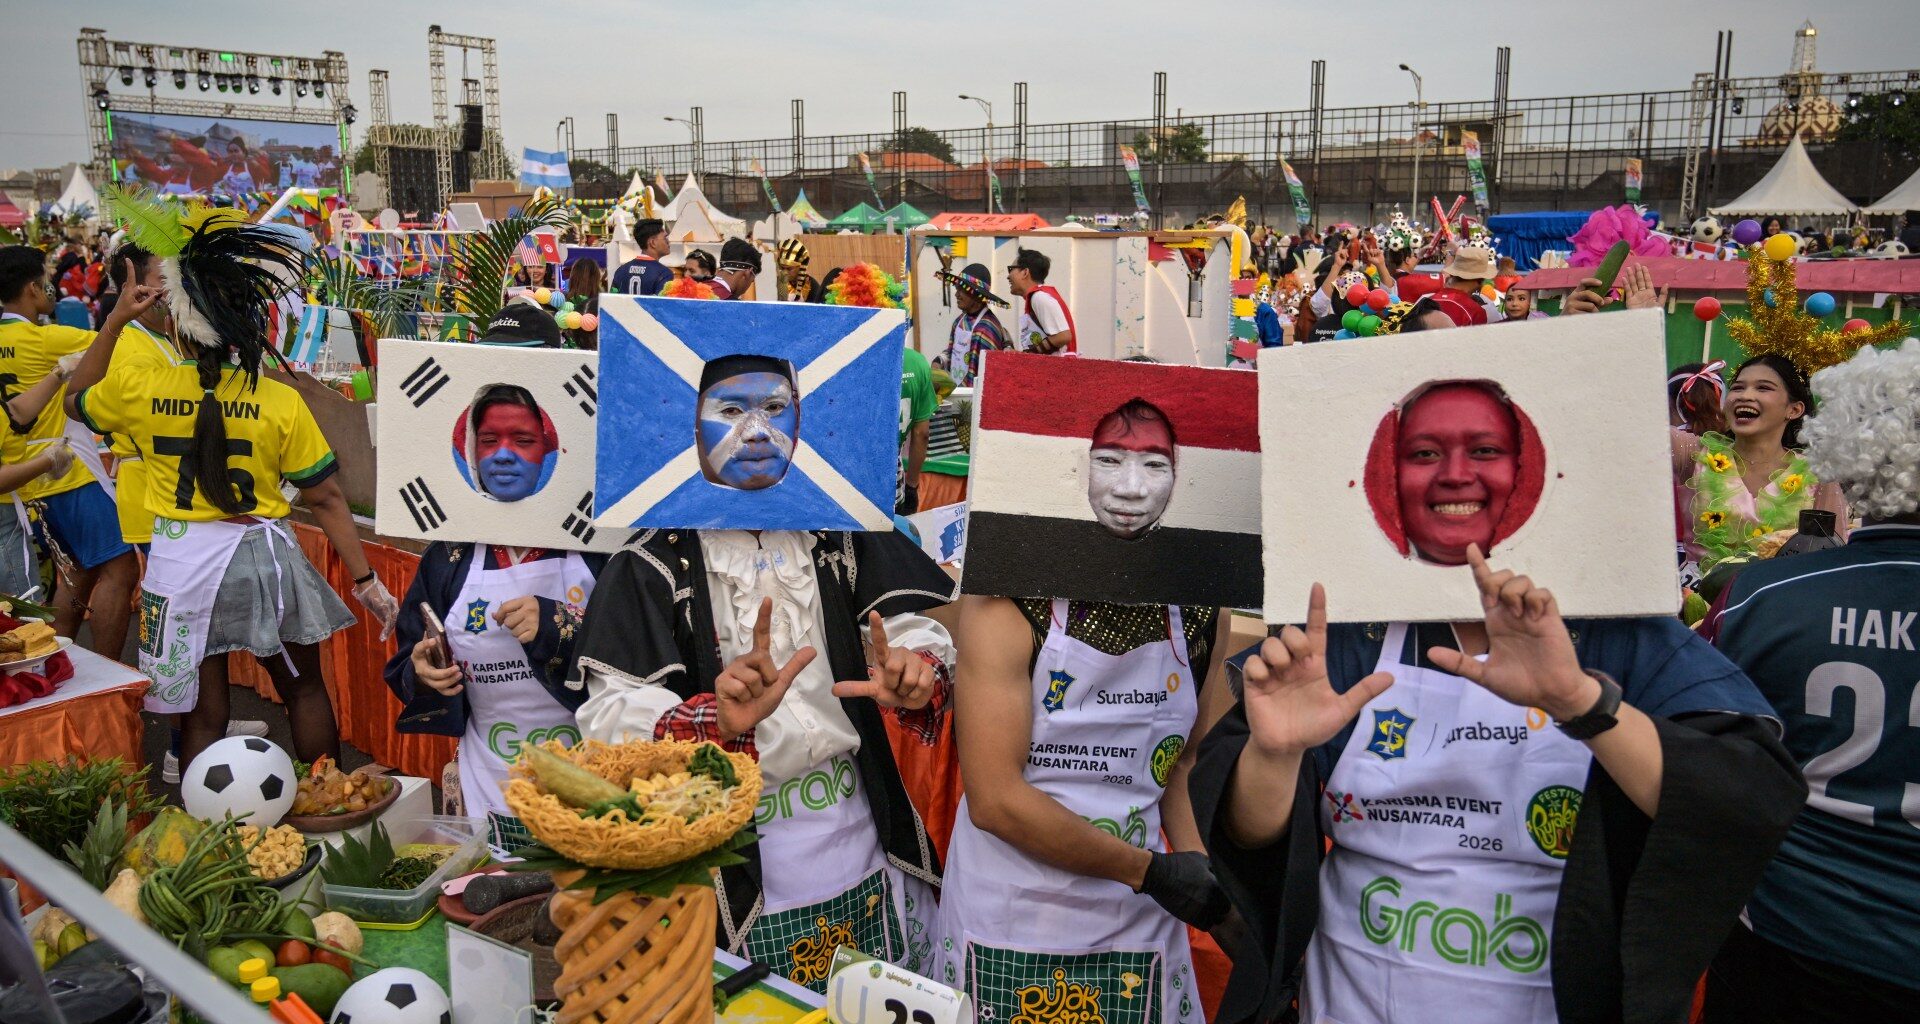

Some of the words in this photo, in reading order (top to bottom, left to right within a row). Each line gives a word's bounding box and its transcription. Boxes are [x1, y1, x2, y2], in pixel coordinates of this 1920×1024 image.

[152, 398, 260, 420] MIDWN
[472, 660, 525, 673] KARISMA
[475, 670, 535, 684] NUSANTAR
[1096, 689, 1168, 707] Surabaya
[1092, 746, 1137, 759] EVENT
[1101, 774, 1133, 785] 2026
[1449, 797, 1502, 815] EVENT
[1367, 808, 1466, 829] NUSANTARA
[1458, 834, 1503, 851] 2026
[1359, 875, 1549, 974] Grab
